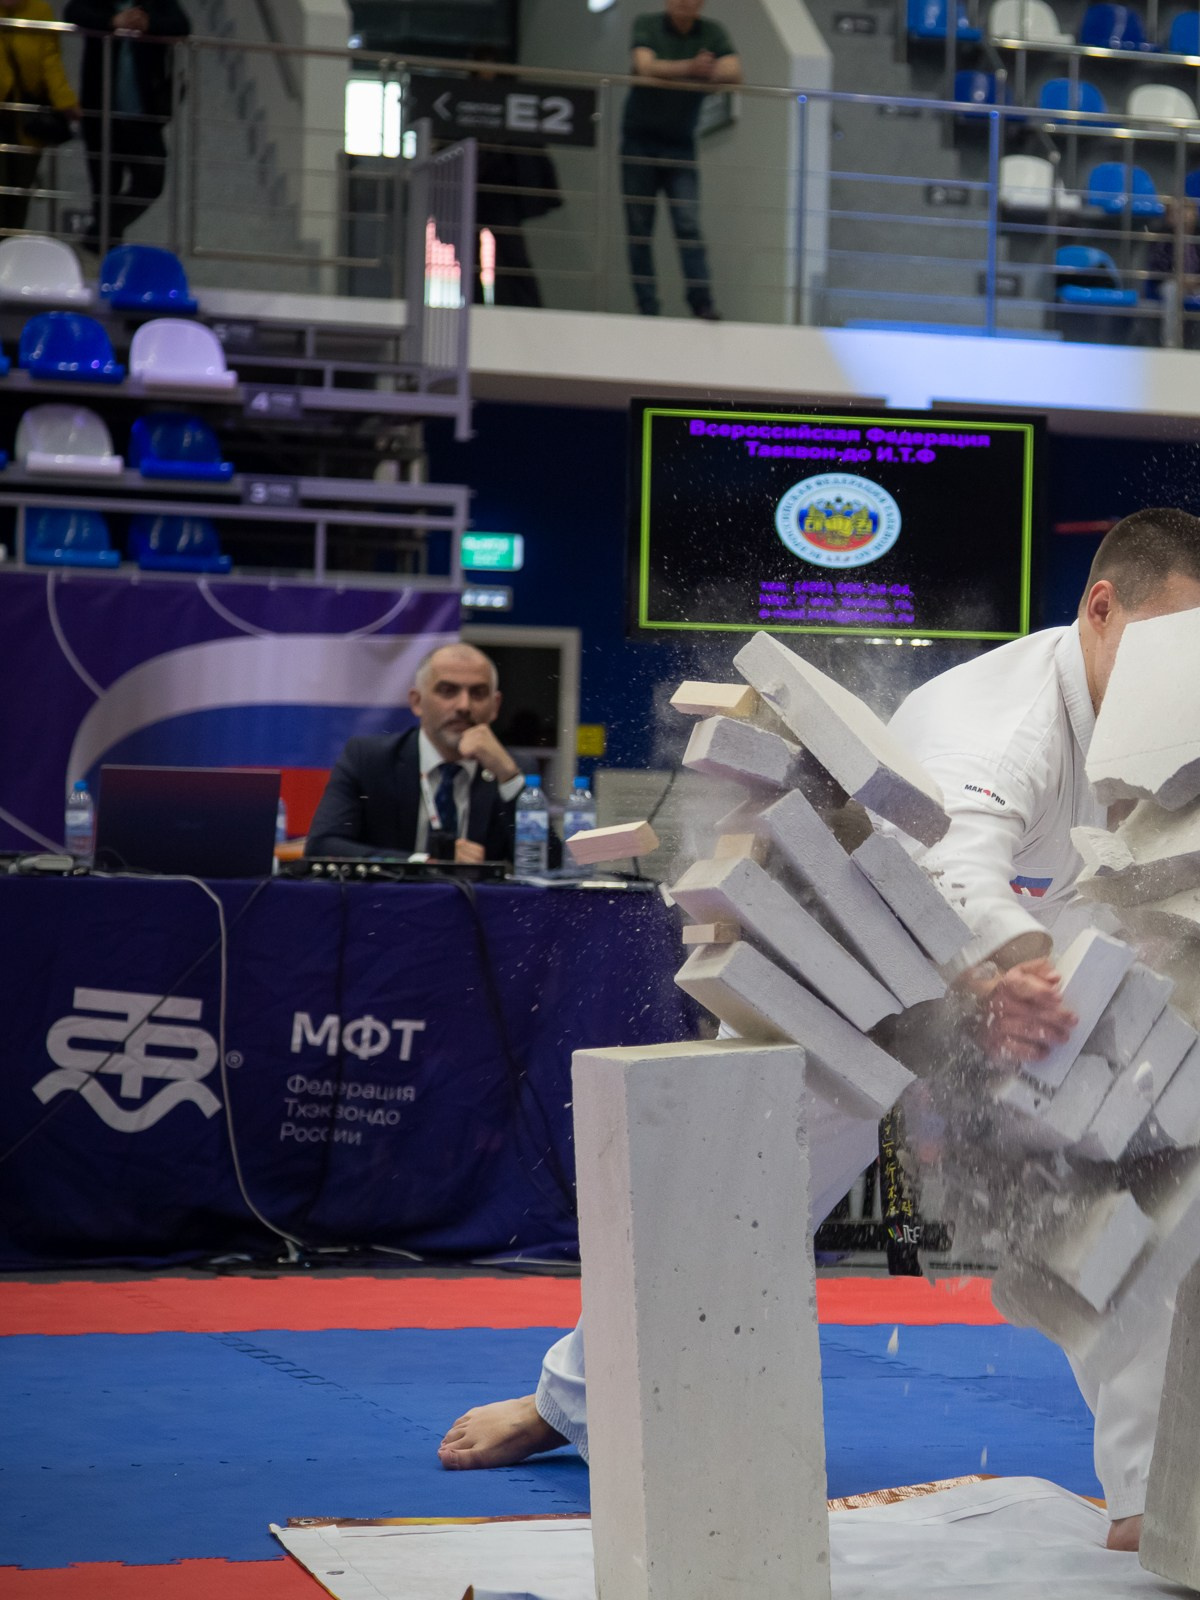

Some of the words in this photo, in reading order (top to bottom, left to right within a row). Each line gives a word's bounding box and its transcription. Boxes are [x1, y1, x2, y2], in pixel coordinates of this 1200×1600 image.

[505, 93, 574, 135] E2
[689, 419, 861, 442] Всероссийская
[866, 427, 991, 448] Федерация
[964, 784, 983, 793] MAX
[990, 792, 1006, 806] PRO
[289, 1011, 427, 1062] МФТ
